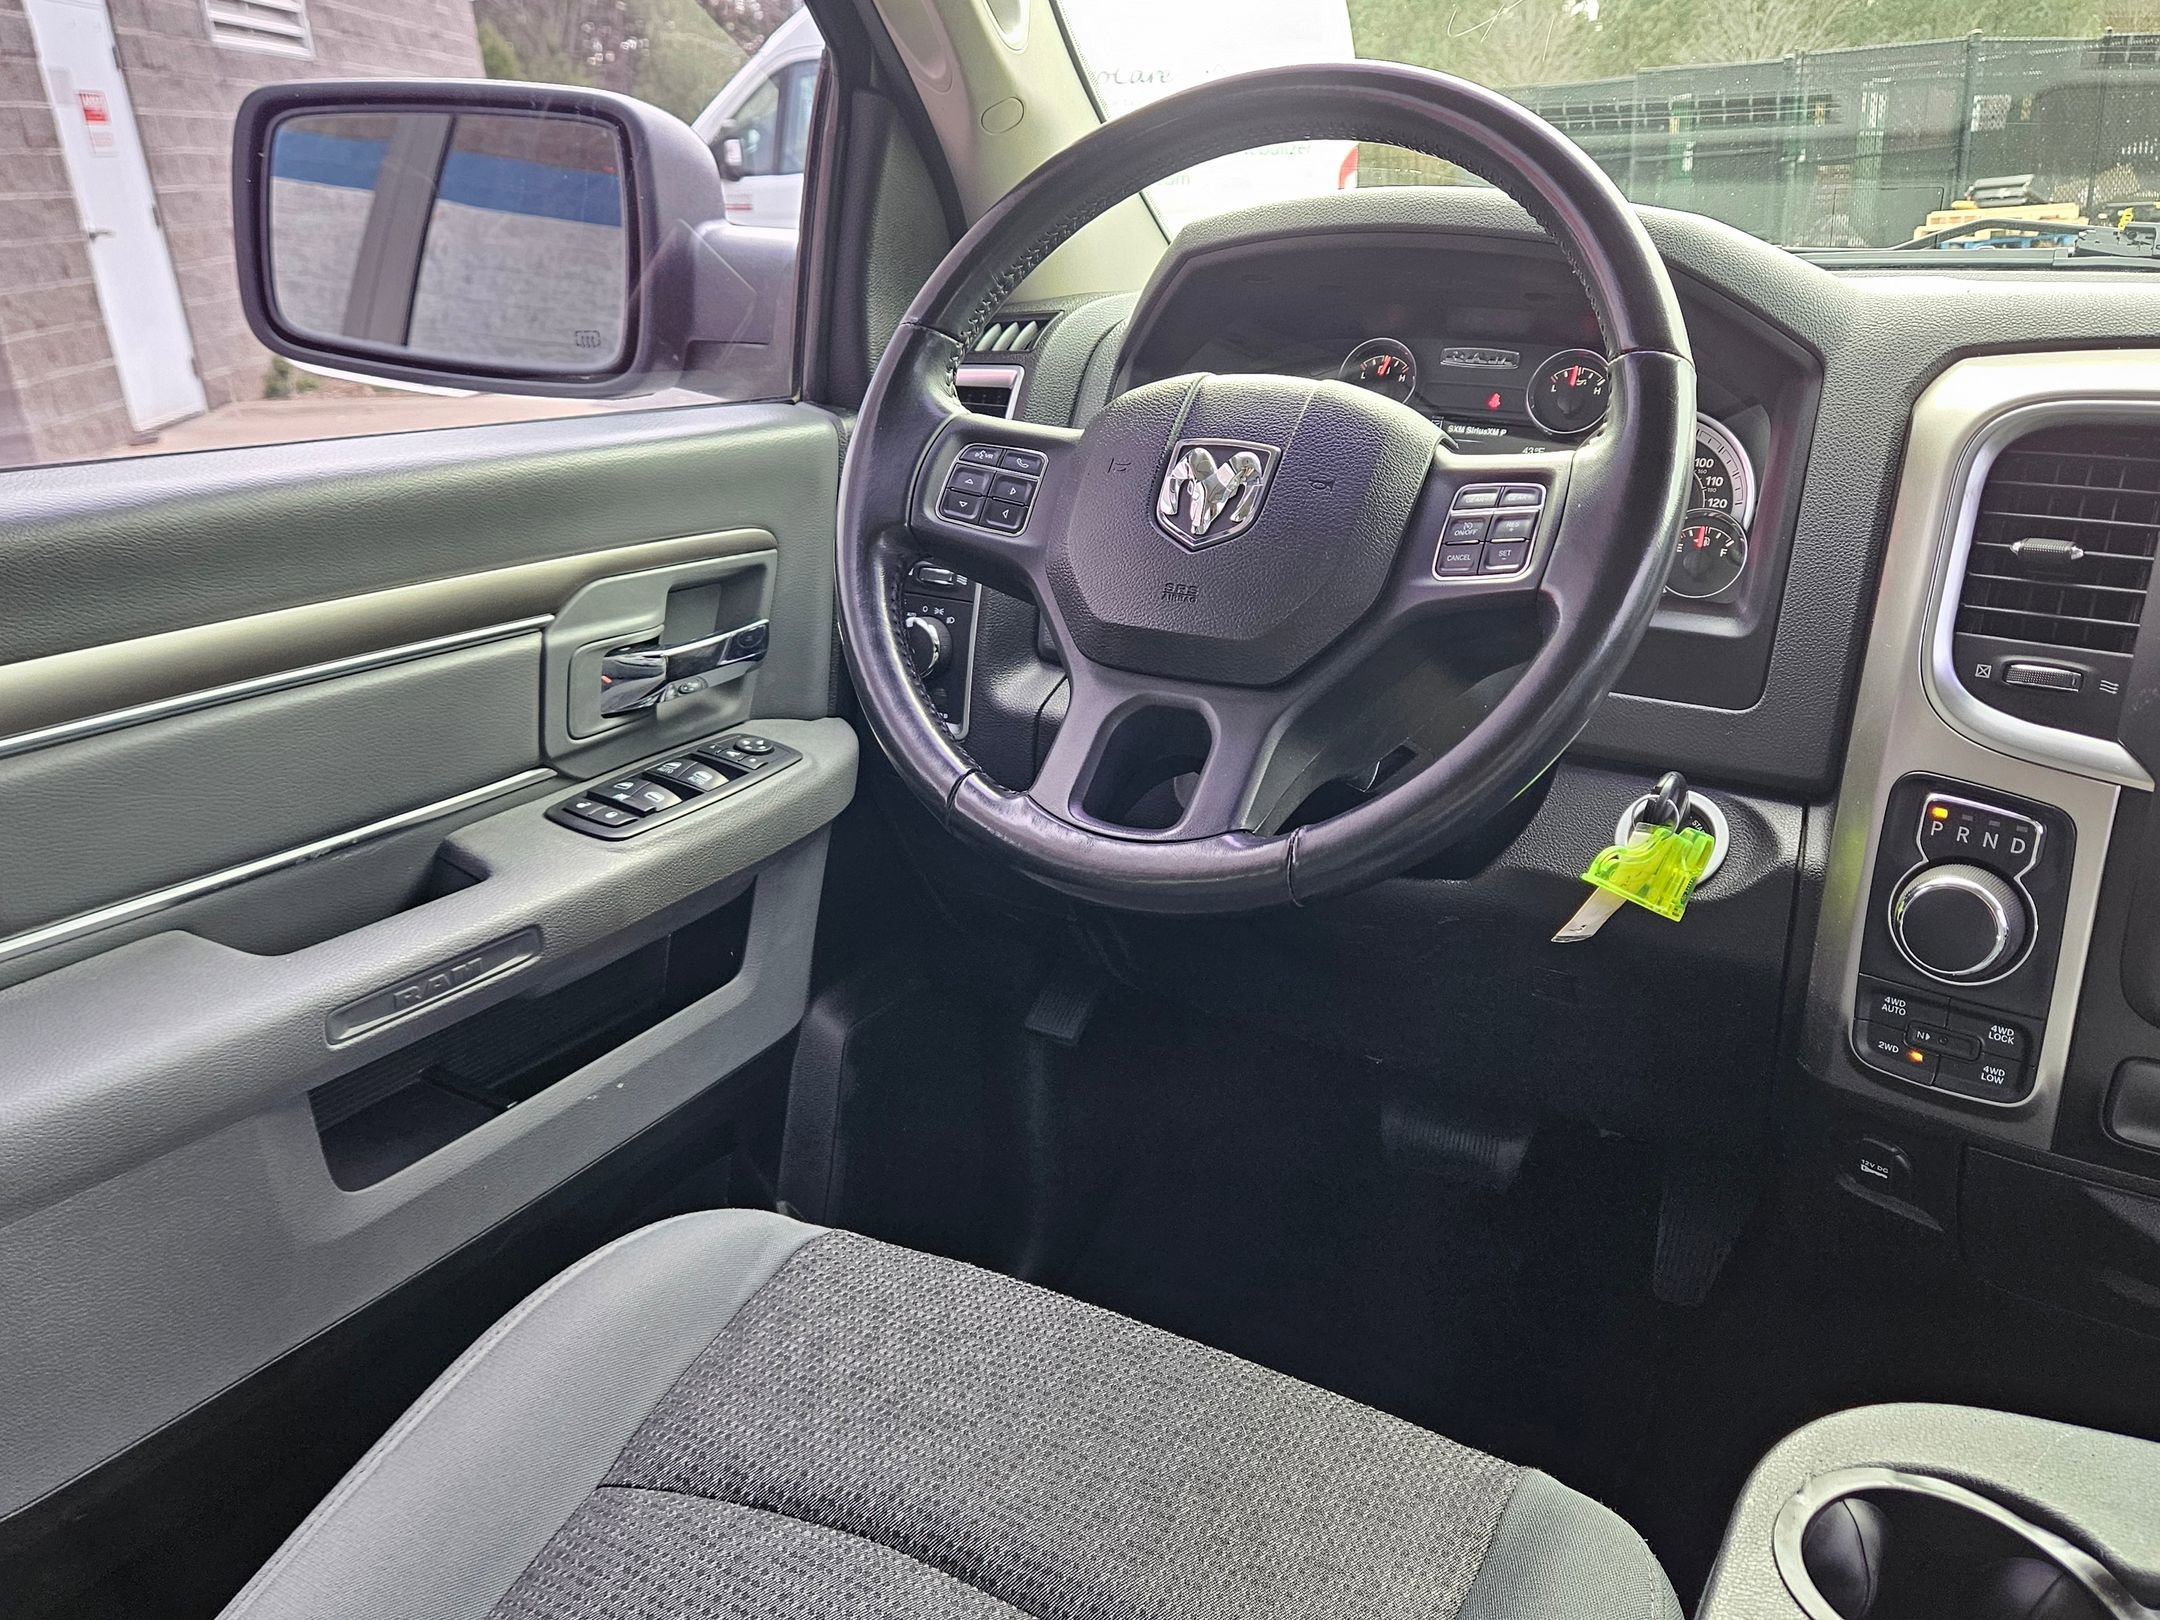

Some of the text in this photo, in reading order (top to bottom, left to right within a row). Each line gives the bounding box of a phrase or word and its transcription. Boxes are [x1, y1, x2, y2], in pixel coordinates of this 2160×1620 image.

[1447, 424, 1465, 434] SXM
[1465, 425, 1499, 436] SiriusXM
[1694, 456, 1714, 468] 100
[1705, 475, 1724, 487] 110
[1707, 498, 1728, 509] 120
[1446, 554, 1471, 562] CANCEL
[1498, 549, 1512, 557] SET
[1719, 548, 1728, 558] F
[1930, 820, 2026, 854] P R N D
[1884, 996, 1906, 1007] 4WD
[1881, 1003, 1906, 1016] AUTO
[1990, 1024, 2015, 1036] 4WD
[1988, 1031, 2015, 1045] LOCK
[1878, 1041, 1900, 1053] 2WD
[1983, 1065, 2005, 1077] 4WD
[1980, 1072, 2004, 1085] LOW
[1861, 1159, 1876, 1169] 12V
